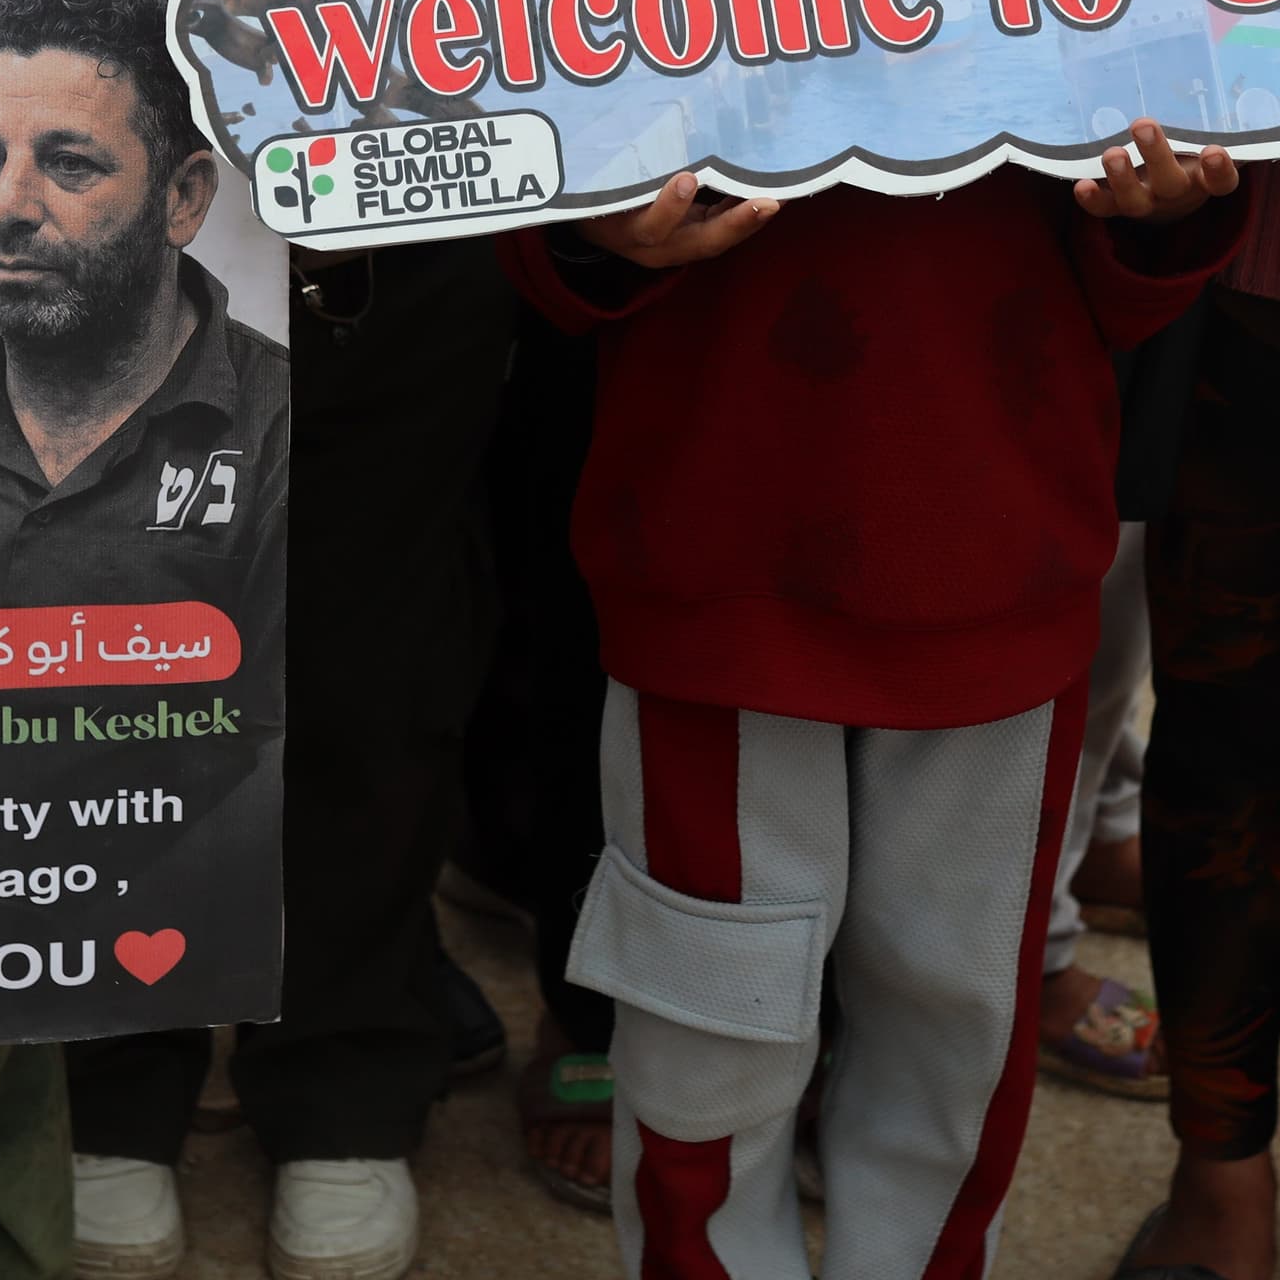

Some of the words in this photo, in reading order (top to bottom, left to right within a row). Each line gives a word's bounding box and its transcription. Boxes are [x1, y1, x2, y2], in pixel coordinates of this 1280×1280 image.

[350, 120, 513, 161] GLOBAL
[353, 151, 492, 190] SUMUD
[356, 173, 546, 219] FLOTILLA
[28, 611, 86, 676] أبو
[98, 623, 212, 672] سيف
[73, 697, 242, 742] Keshek
[68, 787, 184, 827] with
